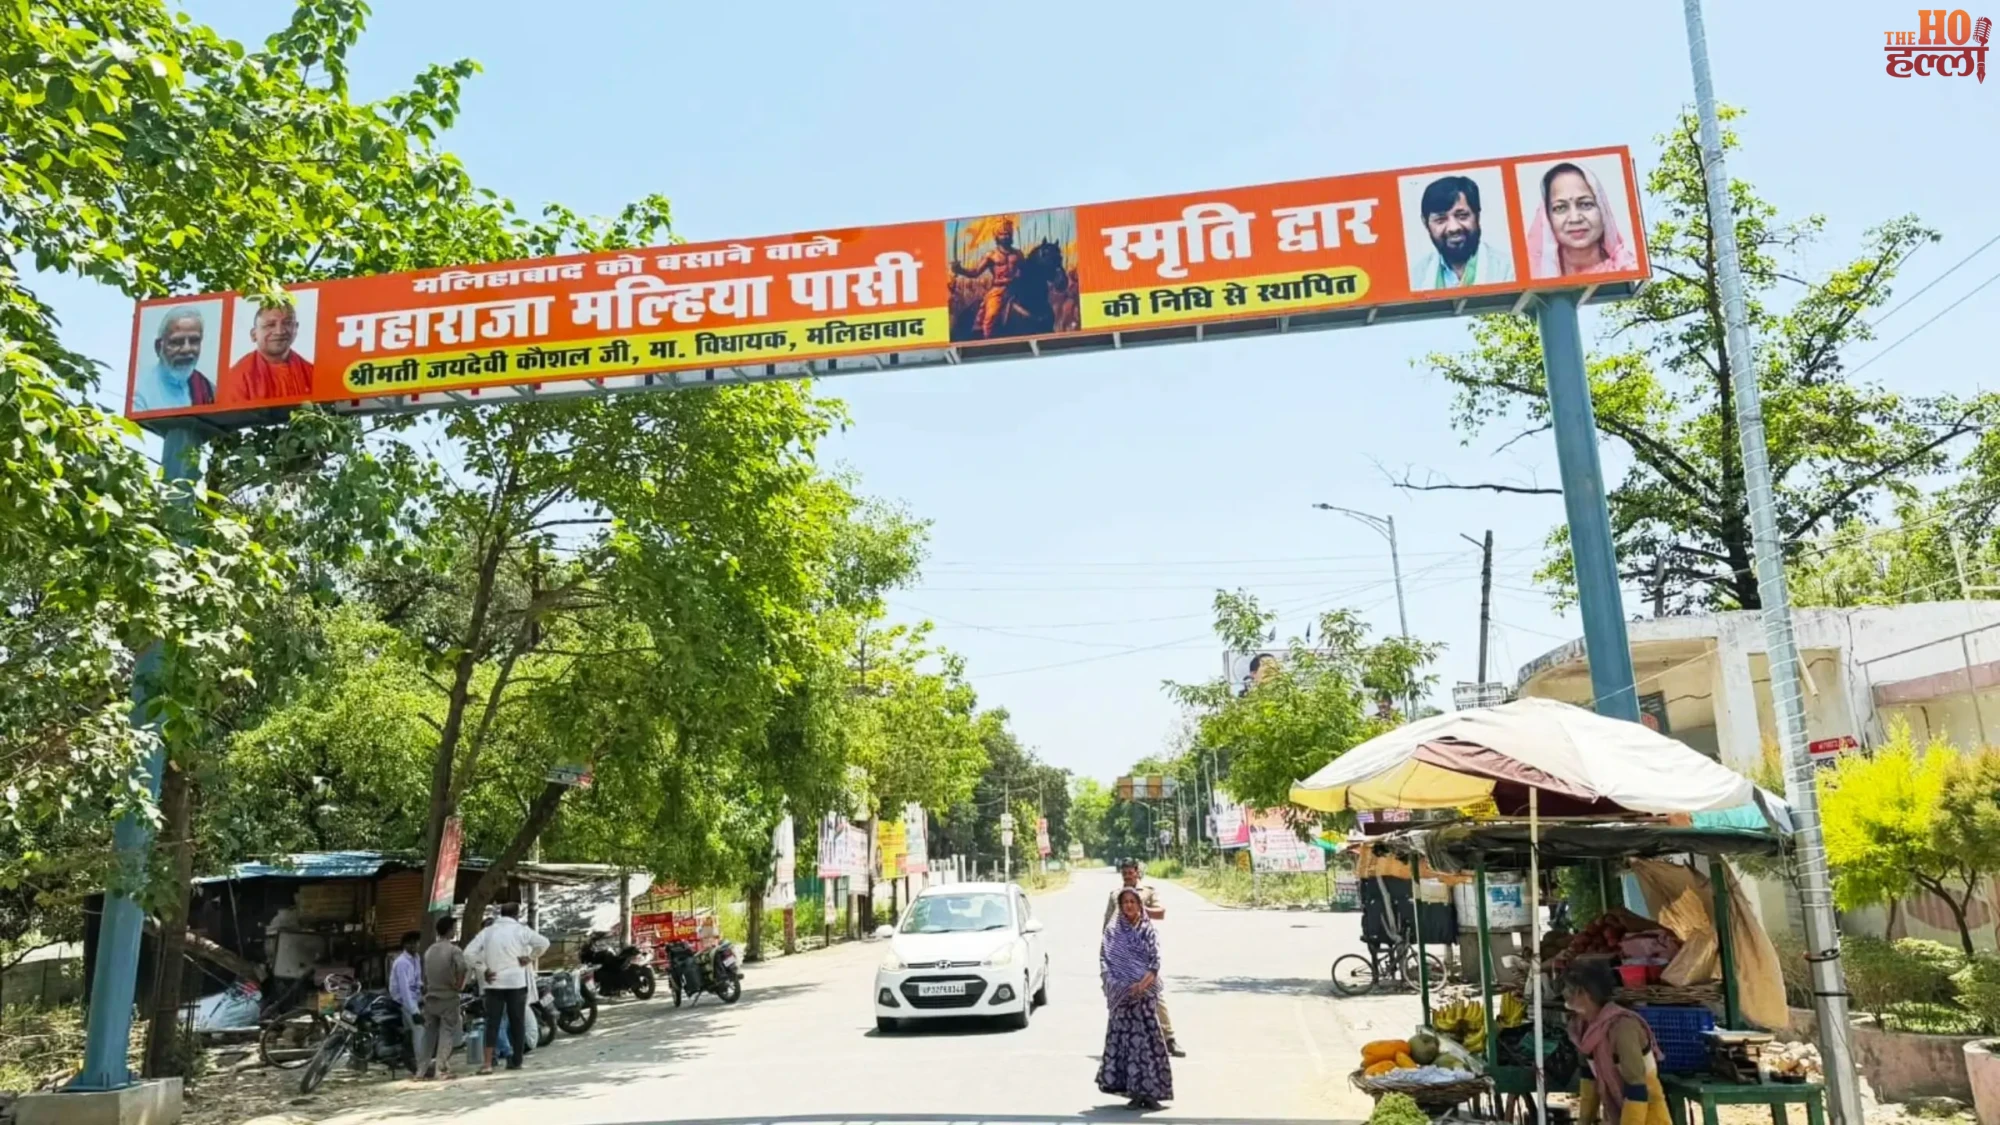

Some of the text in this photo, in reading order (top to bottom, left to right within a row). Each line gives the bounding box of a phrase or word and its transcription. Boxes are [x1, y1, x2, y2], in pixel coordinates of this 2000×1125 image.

[412, 236, 842, 294] मलिहाबाद को बसाने वाले
[1101, 197, 1379, 278] स्मृति द्वार
[336, 251, 923, 352] महाराजा मल्हिया पासी
[1102, 273, 1358, 317] की निधि से स्थापित
[349, 318, 926, 386] श्रीमती जयदेवी कौशल जी, मा. विधायक, मलिहाबाद
